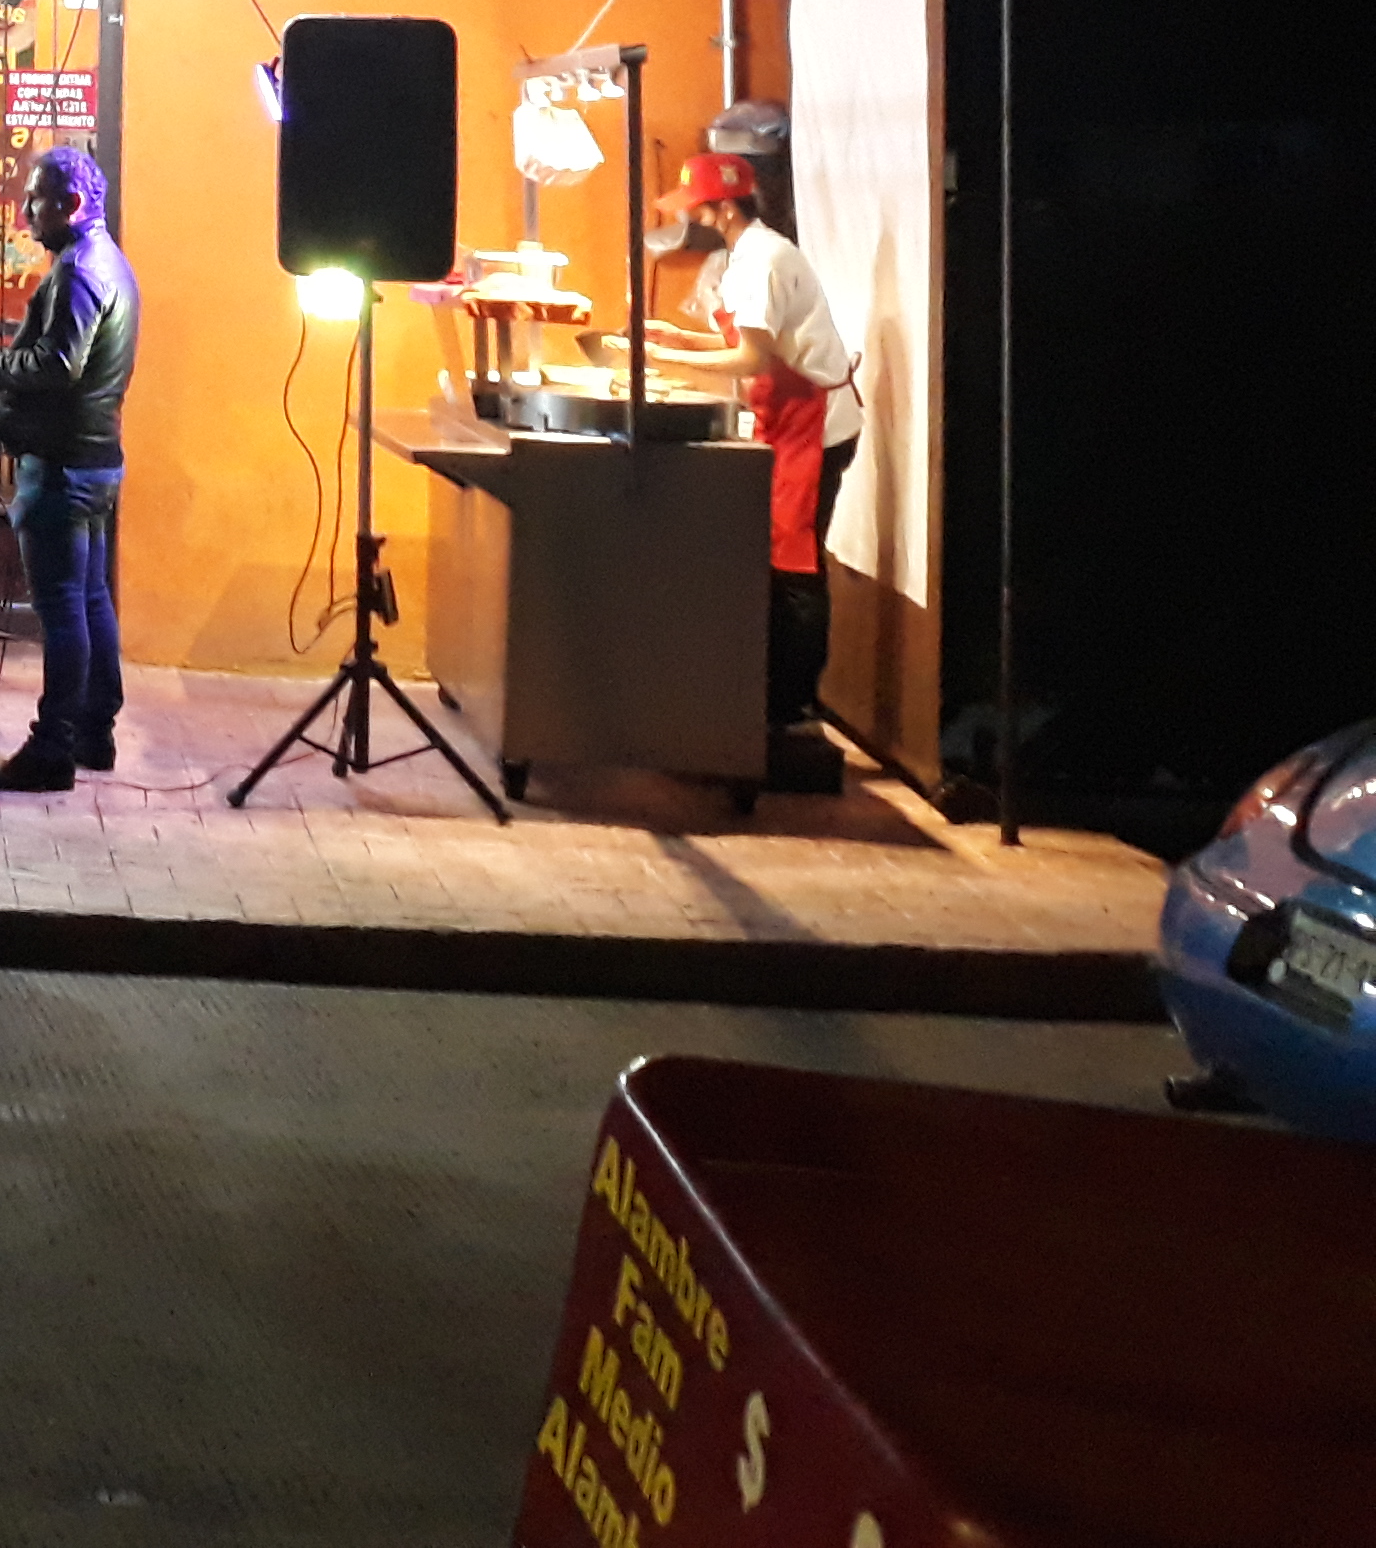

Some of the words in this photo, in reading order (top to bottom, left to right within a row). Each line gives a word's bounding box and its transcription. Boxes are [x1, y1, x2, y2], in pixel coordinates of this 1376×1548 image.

[11, 127, 30, 148] a
[591, 1135, 730, 1373] Alambre
[612, 1253, 684, 1411] Fam
[578, 1324, 678, 1528] Medio
